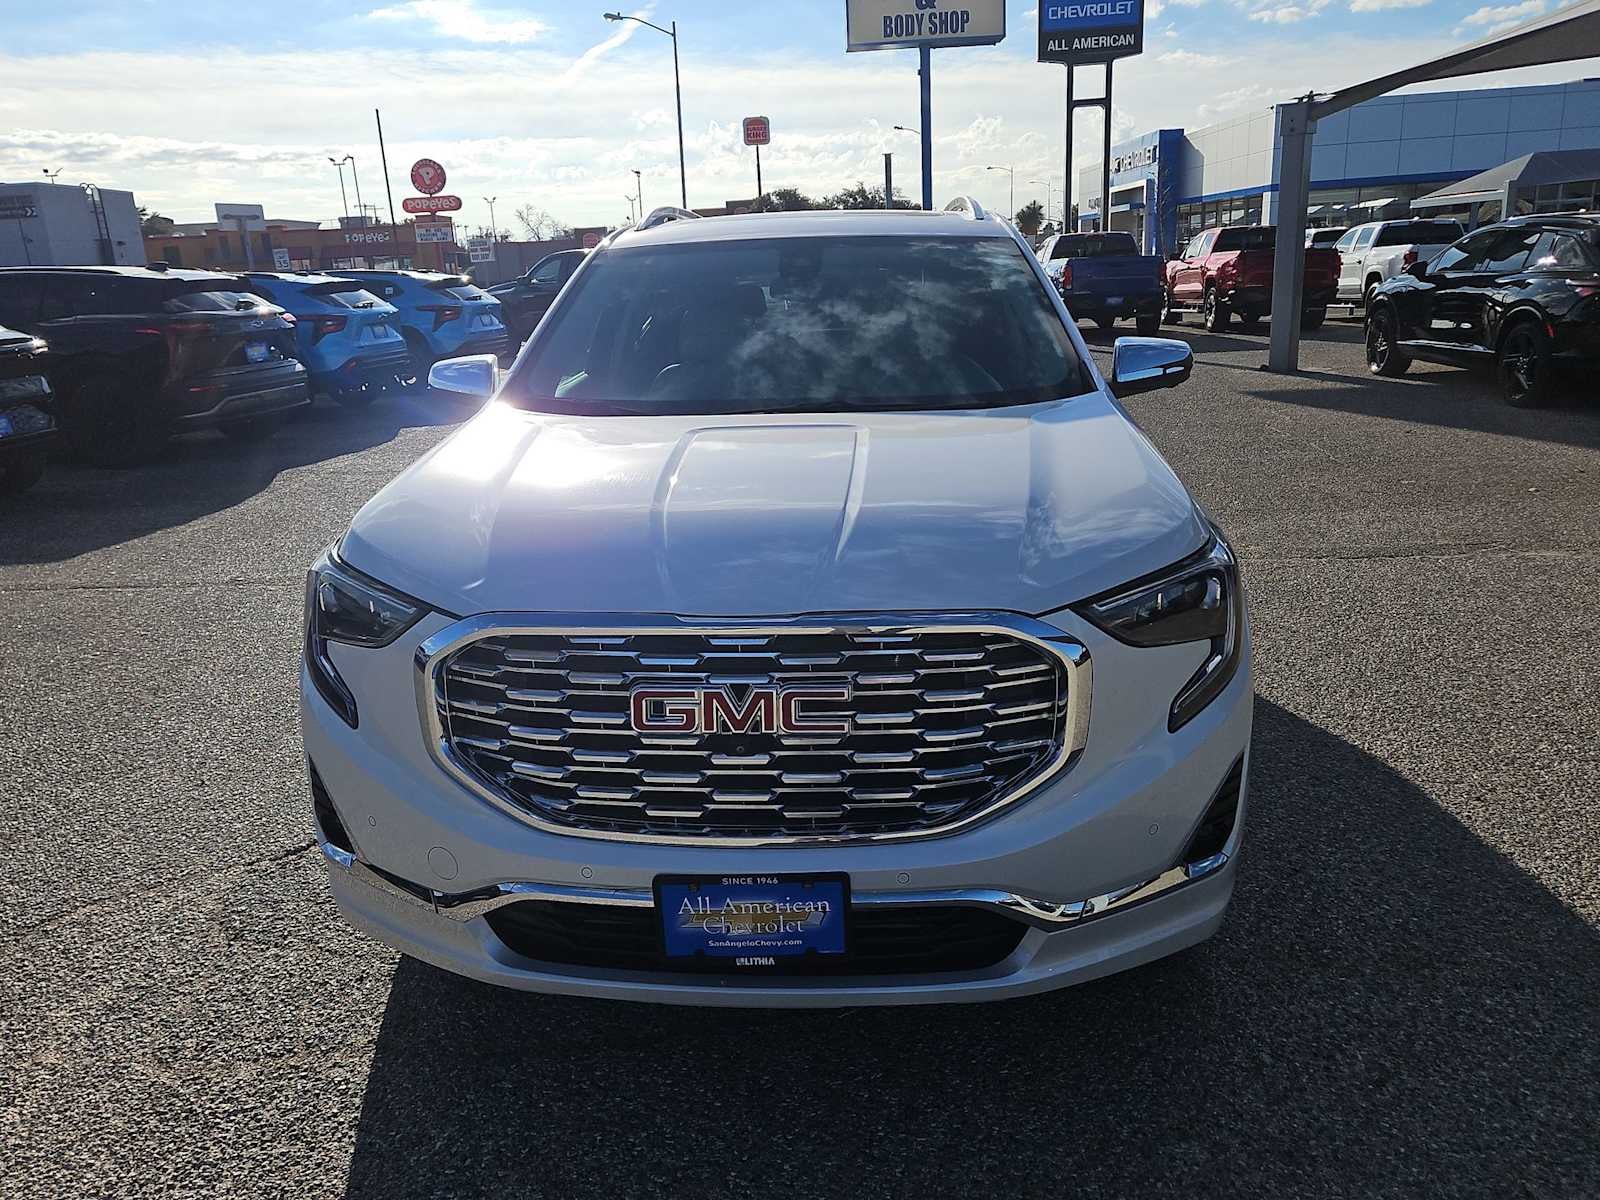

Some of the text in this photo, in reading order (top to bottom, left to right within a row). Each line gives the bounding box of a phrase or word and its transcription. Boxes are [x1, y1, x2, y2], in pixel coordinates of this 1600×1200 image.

[1048, 1, 1134, 19] CHEVROLET
[883, 10, 970, 38] BODY SHOP
[1047, 34, 1135, 51] ALL AMERICAN
[630, 684, 852, 734] GMC
[721, 877, 779, 885] SINCE 1946
[678, 896, 832, 915] All American
[703, 915, 805, 935] Chevrolet
[708, 939, 803, 948] SanAngeloChevy.com
[744, 957, 776, 966] LITHIA
